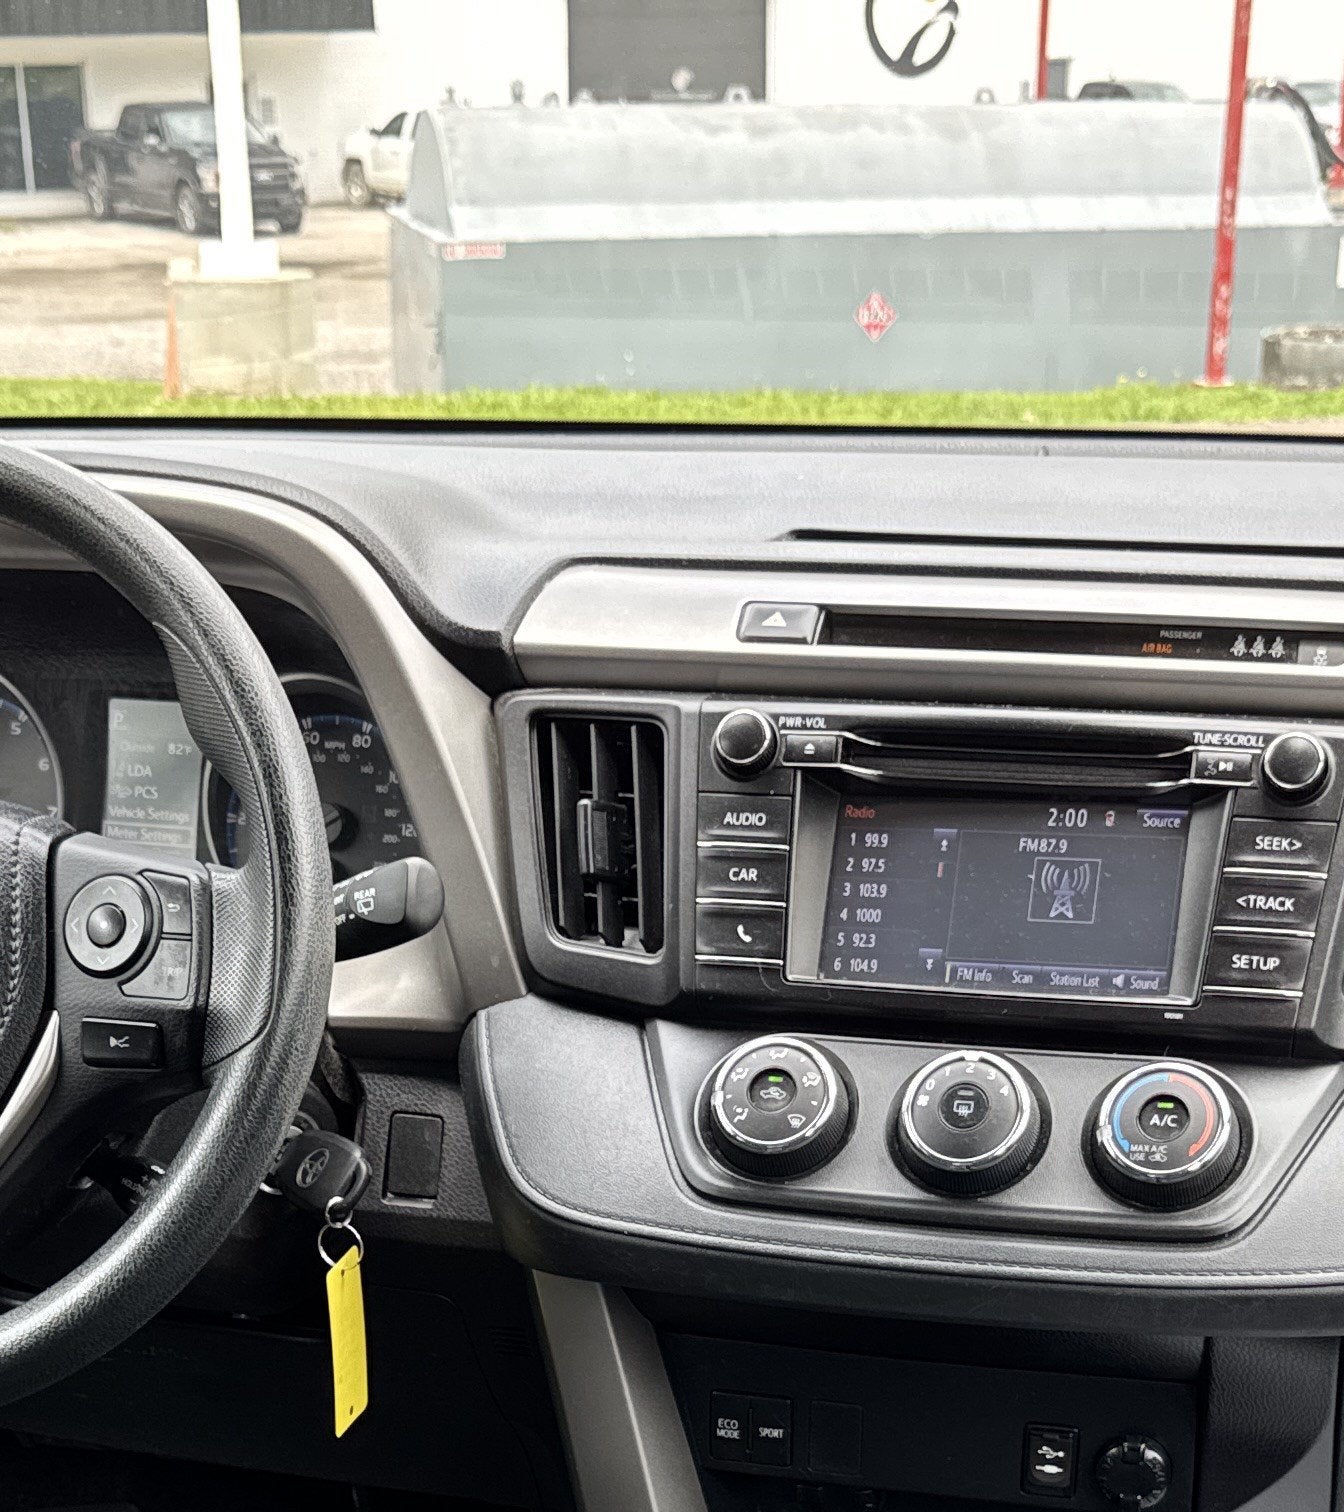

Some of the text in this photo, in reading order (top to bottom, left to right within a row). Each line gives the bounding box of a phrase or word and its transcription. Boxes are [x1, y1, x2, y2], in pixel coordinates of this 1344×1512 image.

[1159, 629, 1202, 640] PASSENGER
[1141, 642, 1173, 654] AIRBAG
[11, 722, 22, 735] 5
[352, 733, 371, 748] 80
[38, 757, 50, 771] 6
[128, 764, 153, 778] LDA
[134, 786, 159, 800] PCS
[108, 806, 190, 825] Vehicle Settings
[845, 804, 876, 819] Radio
[1047, 807, 1088, 828] 2:00
[723, 812, 767, 827] AUDIO
[1142, 812, 1181, 829] Source
[107, 826, 139, 841] Meter
[850, 832, 889, 848] 1 99.9
[846, 857, 887, 873] 2 97.5
[728, 867, 758, 882] CAR
[353, 888, 376, 901] REAR
[843, 882, 888, 898] 3 103.9
[840, 908, 882, 923] 4 1000
[836, 932, 876, 948] 5 92.3
[833, 957, 878, 973] 6 104.9
[1231, 954, 1280, 971] SETUP
[957, 968, 992, 983] FM Info
[1012, 970, 1033, 985] Scan
[1050, 972, 1100, 988] Station List
[1130, 977, 1159, 990] Sound
[925, 1063, 1009, 1097] 0 1 2 3 4
[1149, 1114, 1179, 1128] A/C
[1130, 1143, 1168, 1154] MAX A/C
[1129, 1152, 1146, 1161] USE
[717, 1417, 739, 1430] ECO
[717, 1428, 740, 1439] MODE
[759, 1427, 784, 1439] SPORT
